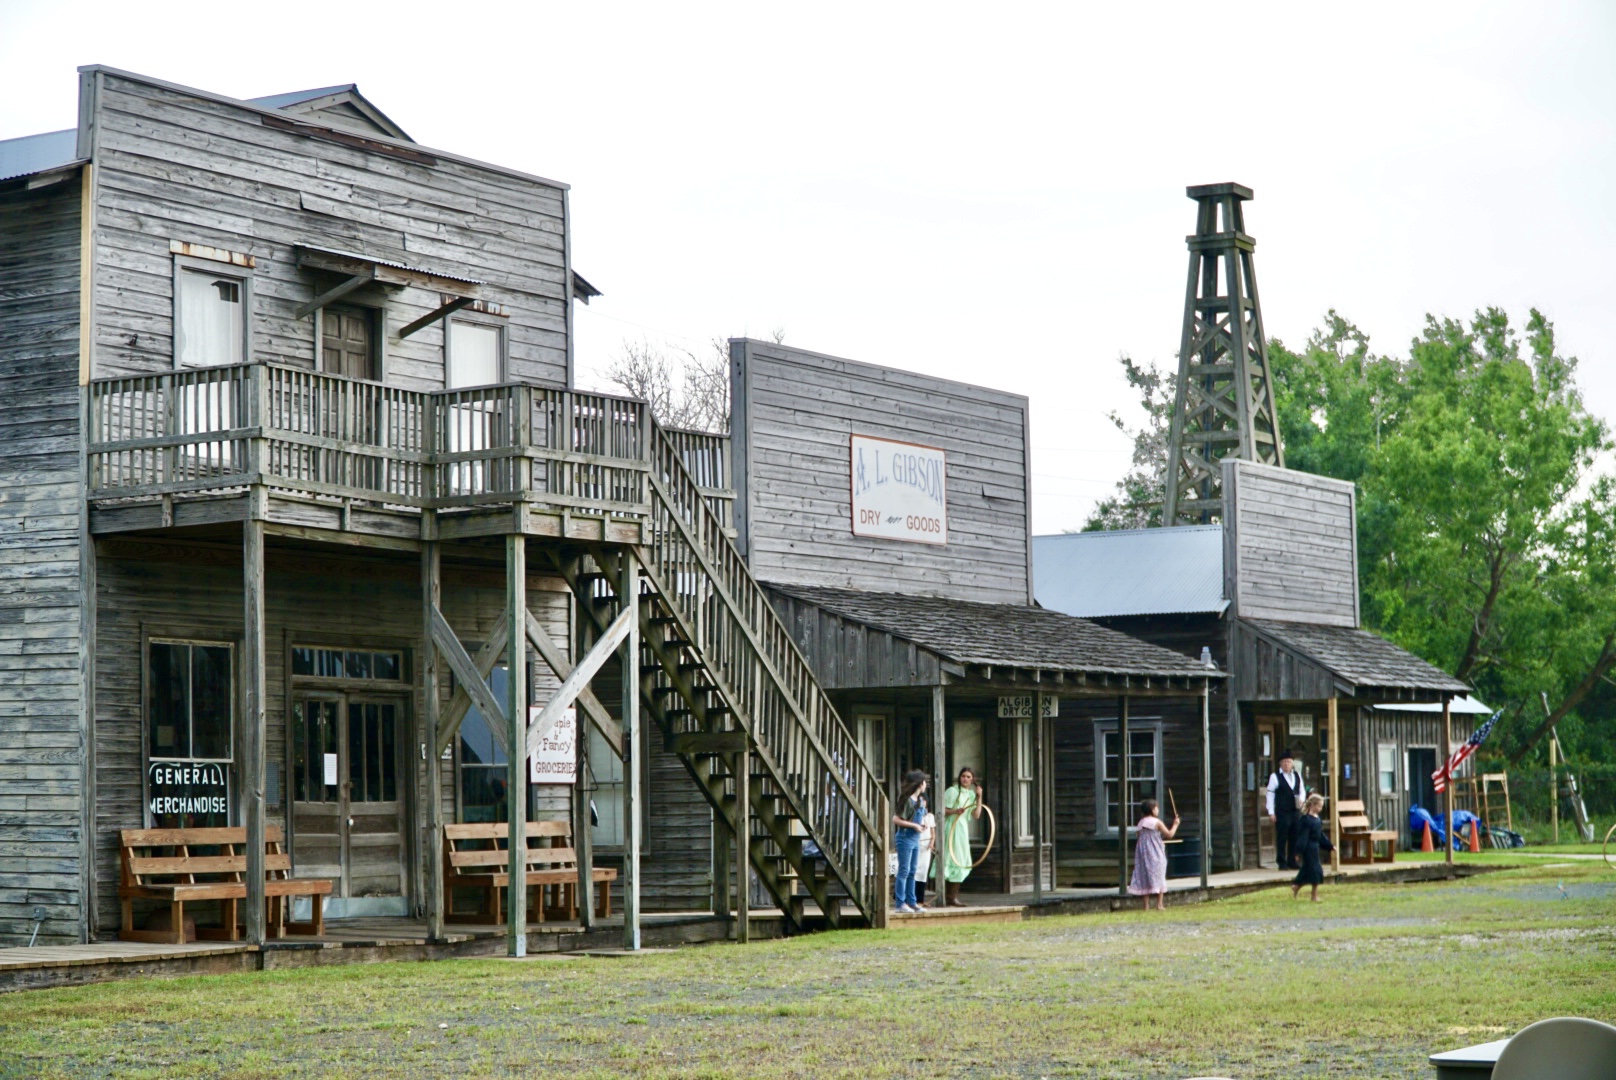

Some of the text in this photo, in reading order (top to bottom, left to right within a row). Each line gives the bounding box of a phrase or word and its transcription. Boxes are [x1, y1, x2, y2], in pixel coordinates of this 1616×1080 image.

[855, 447, 943, 507] A. L. GIBSON
[860, 509, 881, 526] DRY
[906, 515, 941, 533] GOODS
[1014, 697, 1052, 707] GIBN
[1003, 707, 1020, 716] DRY
[542, 738, 571, 754] Fancy
[155, 768, 218, 785] GENERAL
[149, 797, 226, 813] MERCHANDISE
